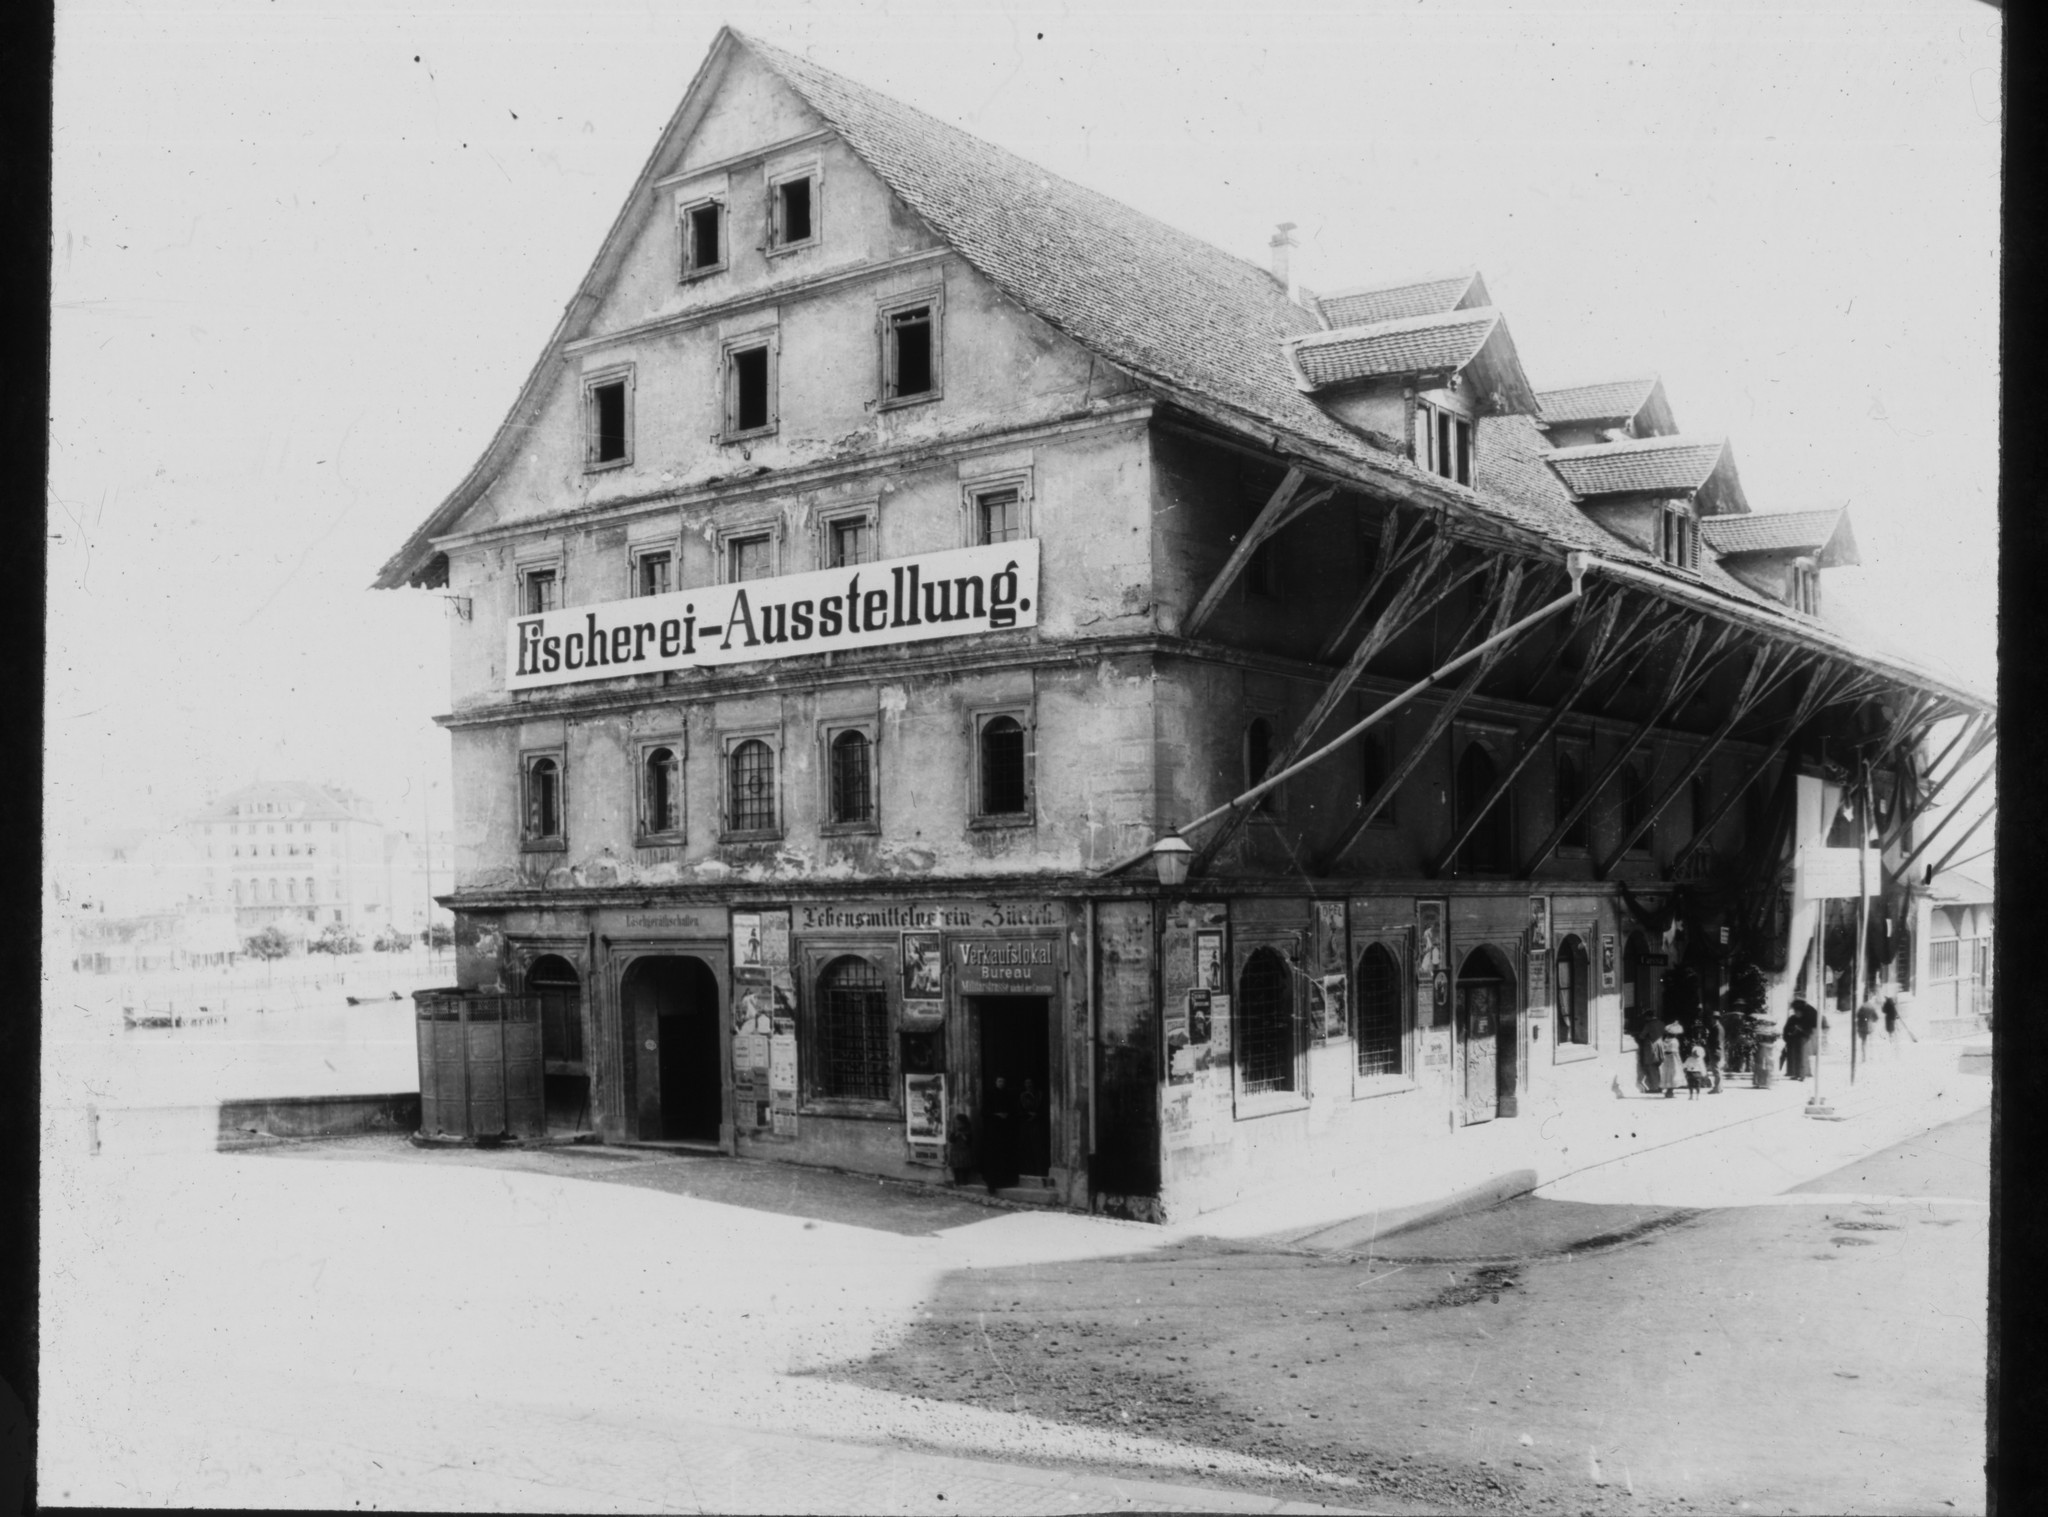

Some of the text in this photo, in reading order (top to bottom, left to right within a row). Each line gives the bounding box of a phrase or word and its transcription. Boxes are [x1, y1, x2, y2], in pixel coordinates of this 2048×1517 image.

[516, 560, 1031, 677] Fischerei-Ausstellung.
[959, 942, 1053, 966] Verkaufslokal
[981, 966, 1031, 979] Bureau
